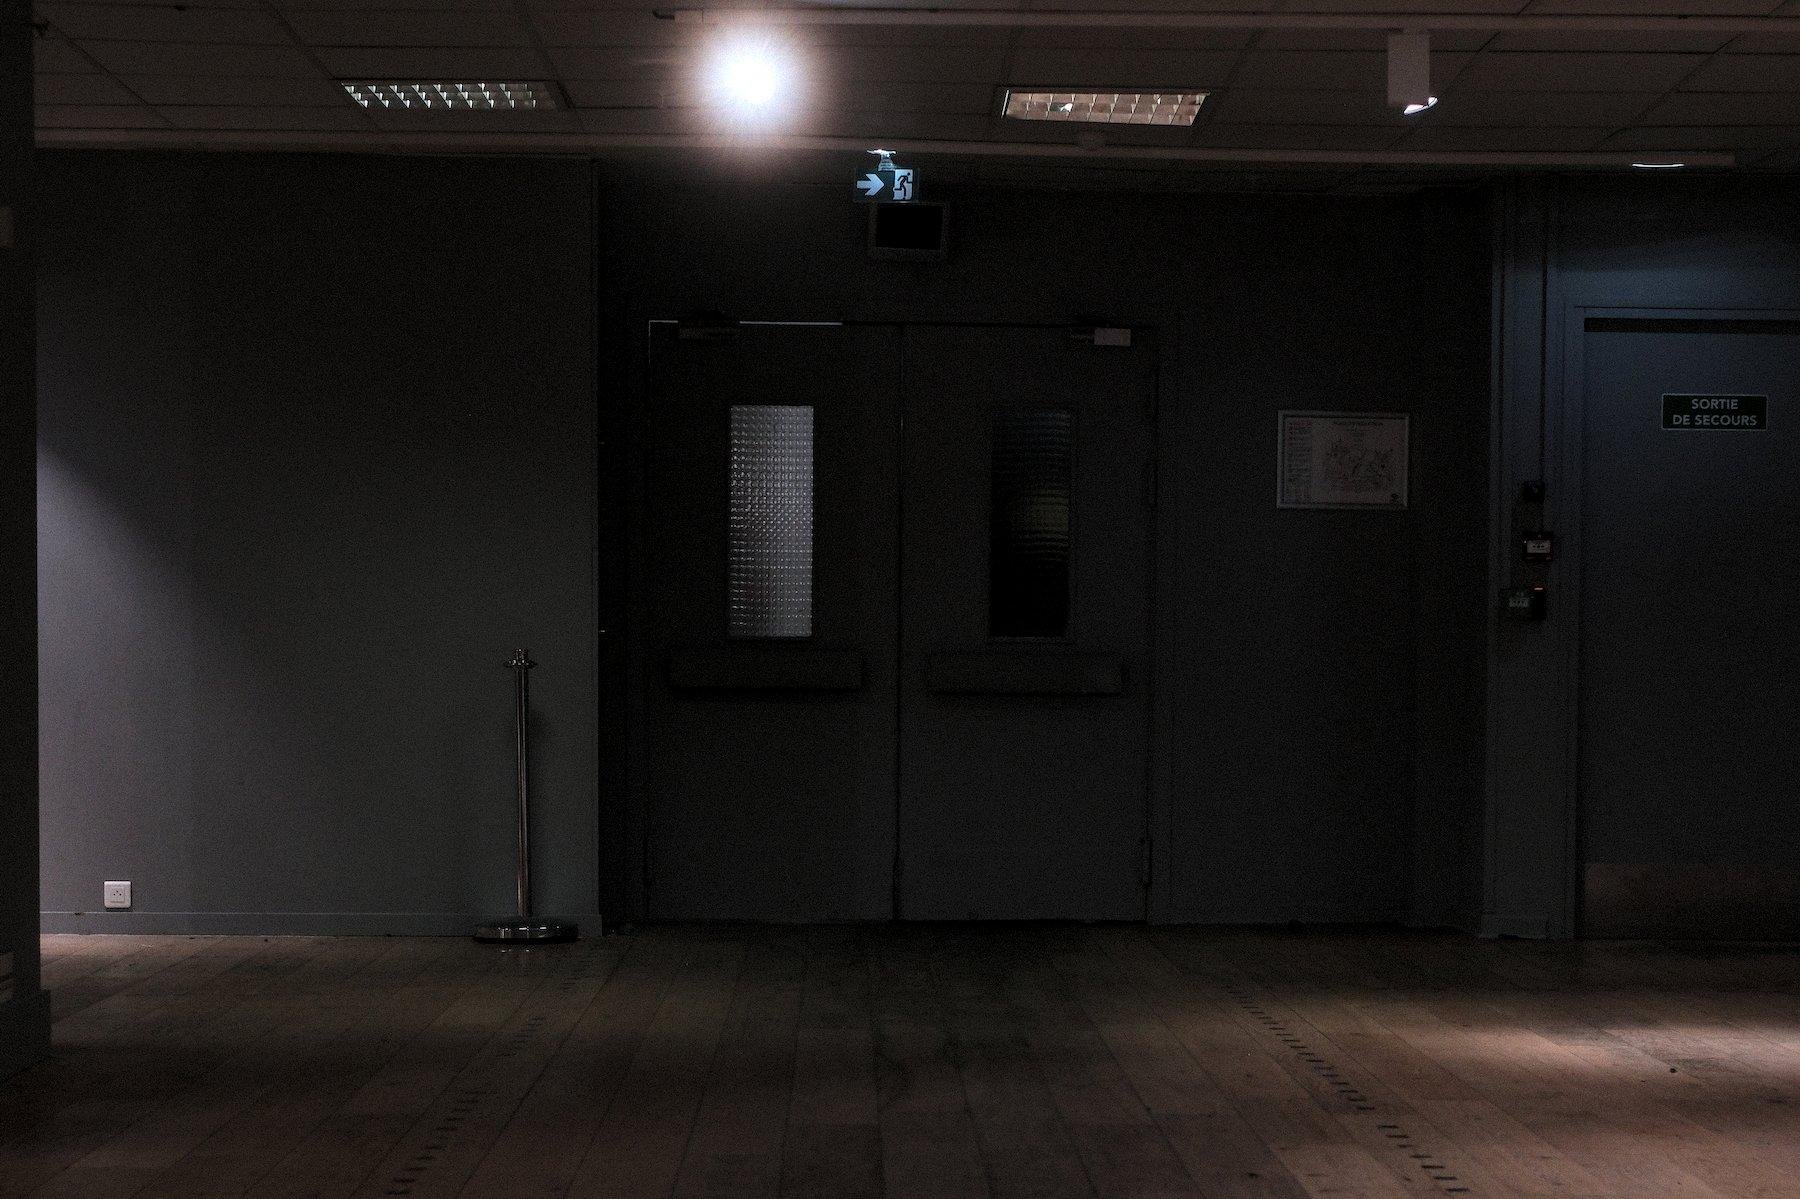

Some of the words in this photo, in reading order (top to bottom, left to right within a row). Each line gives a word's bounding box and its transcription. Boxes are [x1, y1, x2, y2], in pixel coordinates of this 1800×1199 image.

[1692, 399, 1739, 410] SORTIE
[1673, 415, 1691, 425] DE
[1695, 415, 1757, 426] SECOURS
